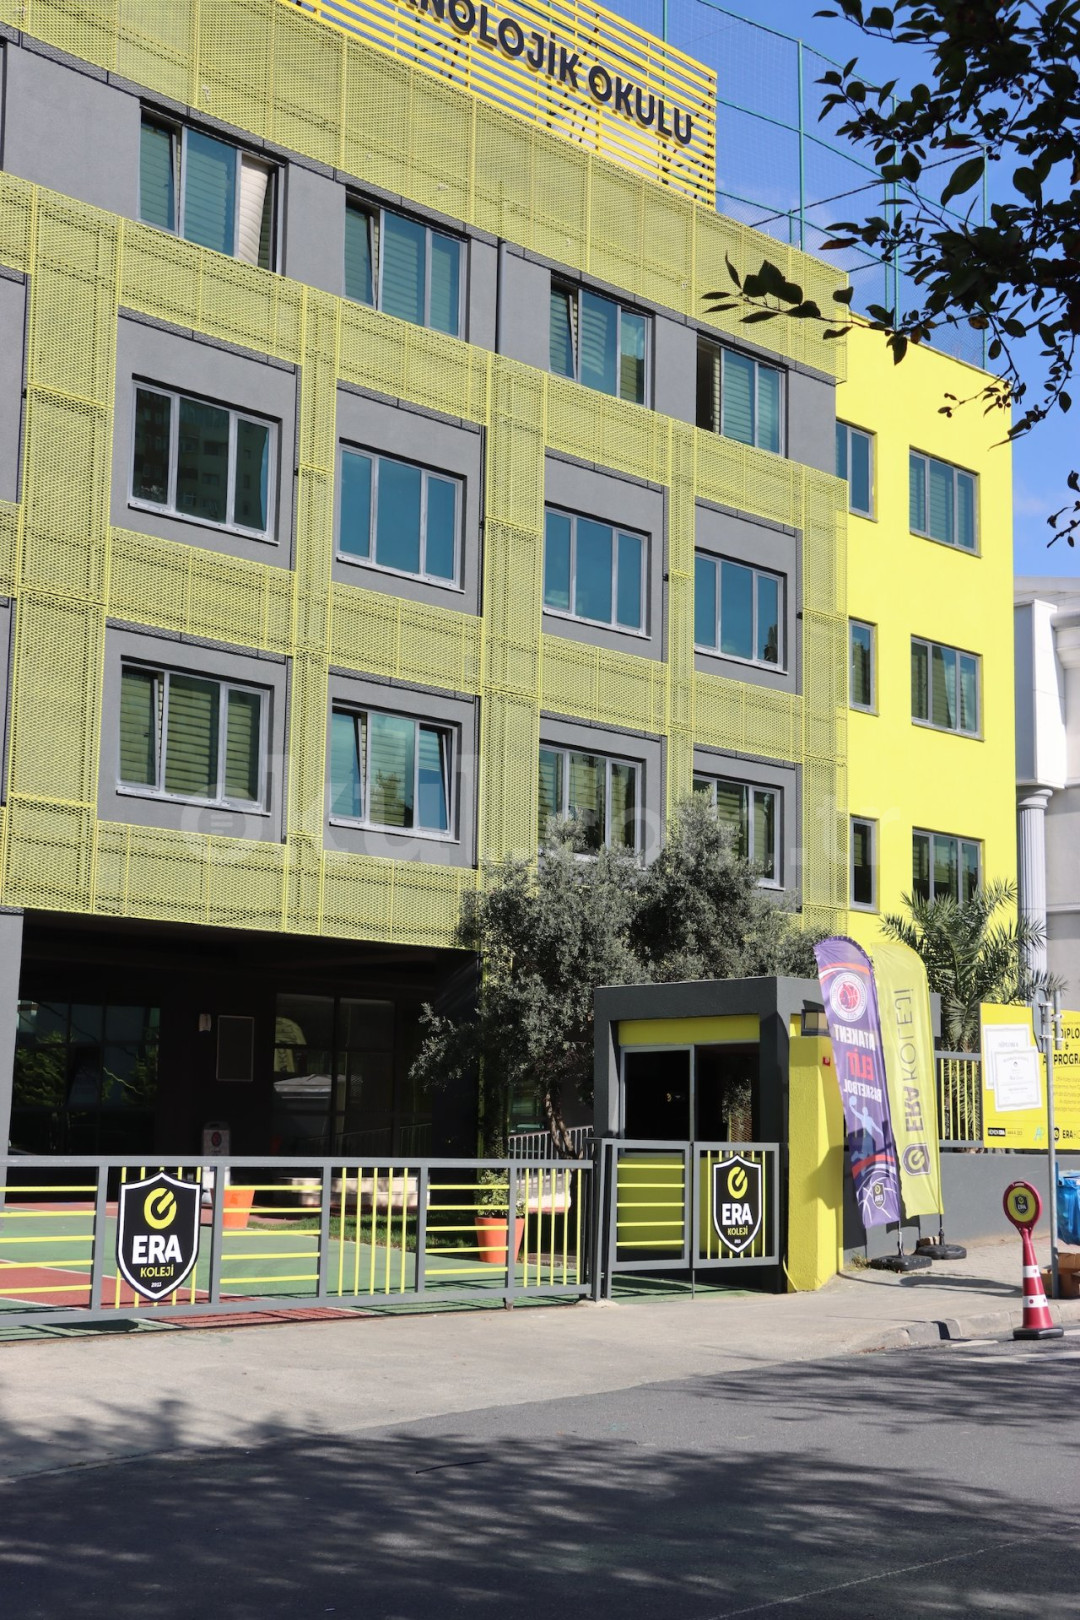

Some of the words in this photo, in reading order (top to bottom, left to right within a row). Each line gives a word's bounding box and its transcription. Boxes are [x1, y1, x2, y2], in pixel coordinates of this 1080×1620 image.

[405, 0, 580, 90] NOLOJİK
[587, 65, 693, 146] OKULU
[1054, 1053, 1080, 1066] PROGR
[722, 1203, 754, 1226] ERA
[727, 1225, 748, 1236] KOLEJİ
[132, 1234, 183, 1264] ERA
[140, 1264, 174, 1278] KOLEJİ
